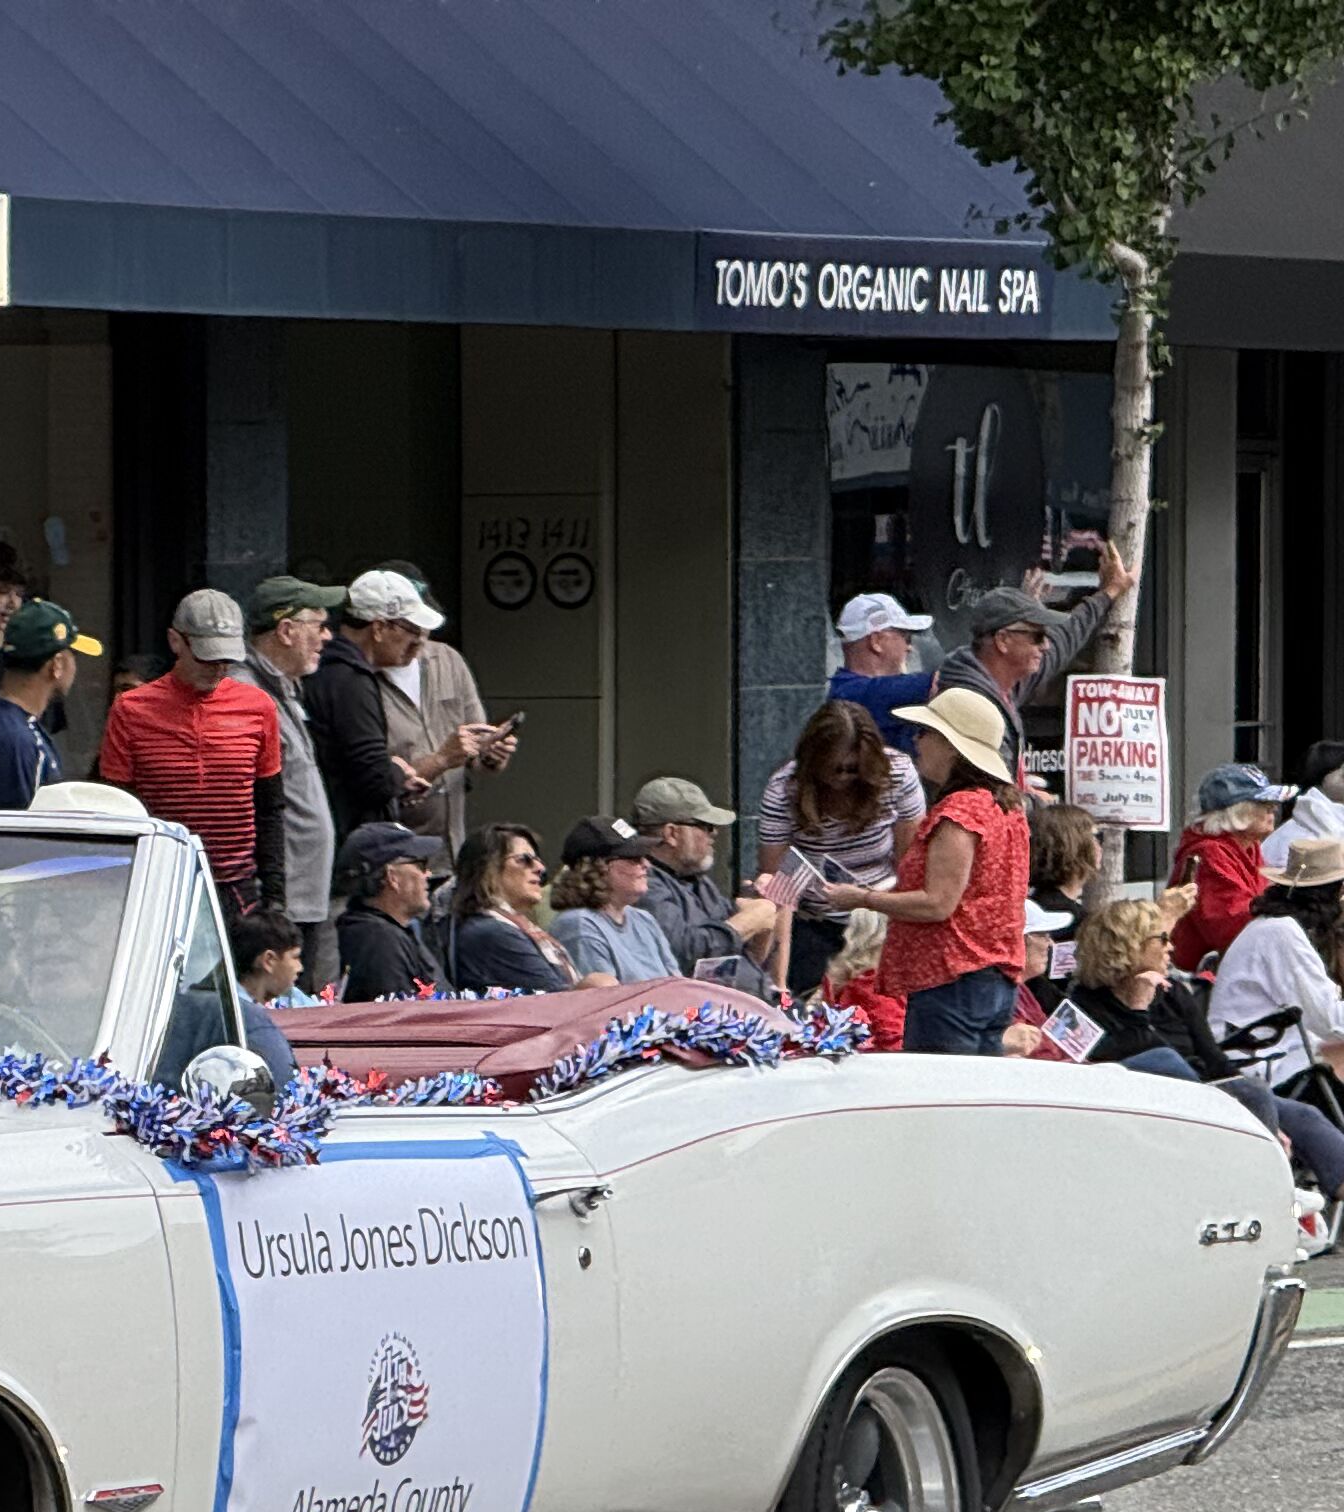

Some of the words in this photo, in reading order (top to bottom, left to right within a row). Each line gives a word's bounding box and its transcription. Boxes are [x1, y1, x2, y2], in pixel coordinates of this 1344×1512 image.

[715, 260, 808, 309] TOMO'S
[817, 263, 930, 314] ORGANIC
[939, 268, 991, 314] NAIL
[998, 269, 1040, 314] SPA
[1076, 682, 1155, 703] TOW-AWAY
[1077, 701, 1121, 736] NO
[1123, 707, 1155, 721] JULY
[1076, 740, 1157, 769] PARKING
[237, 1212, 334, 1280] Ursula
[339, 1213, 418, 1273] Jones
[418, 1202, 529, 1266] Dickson
